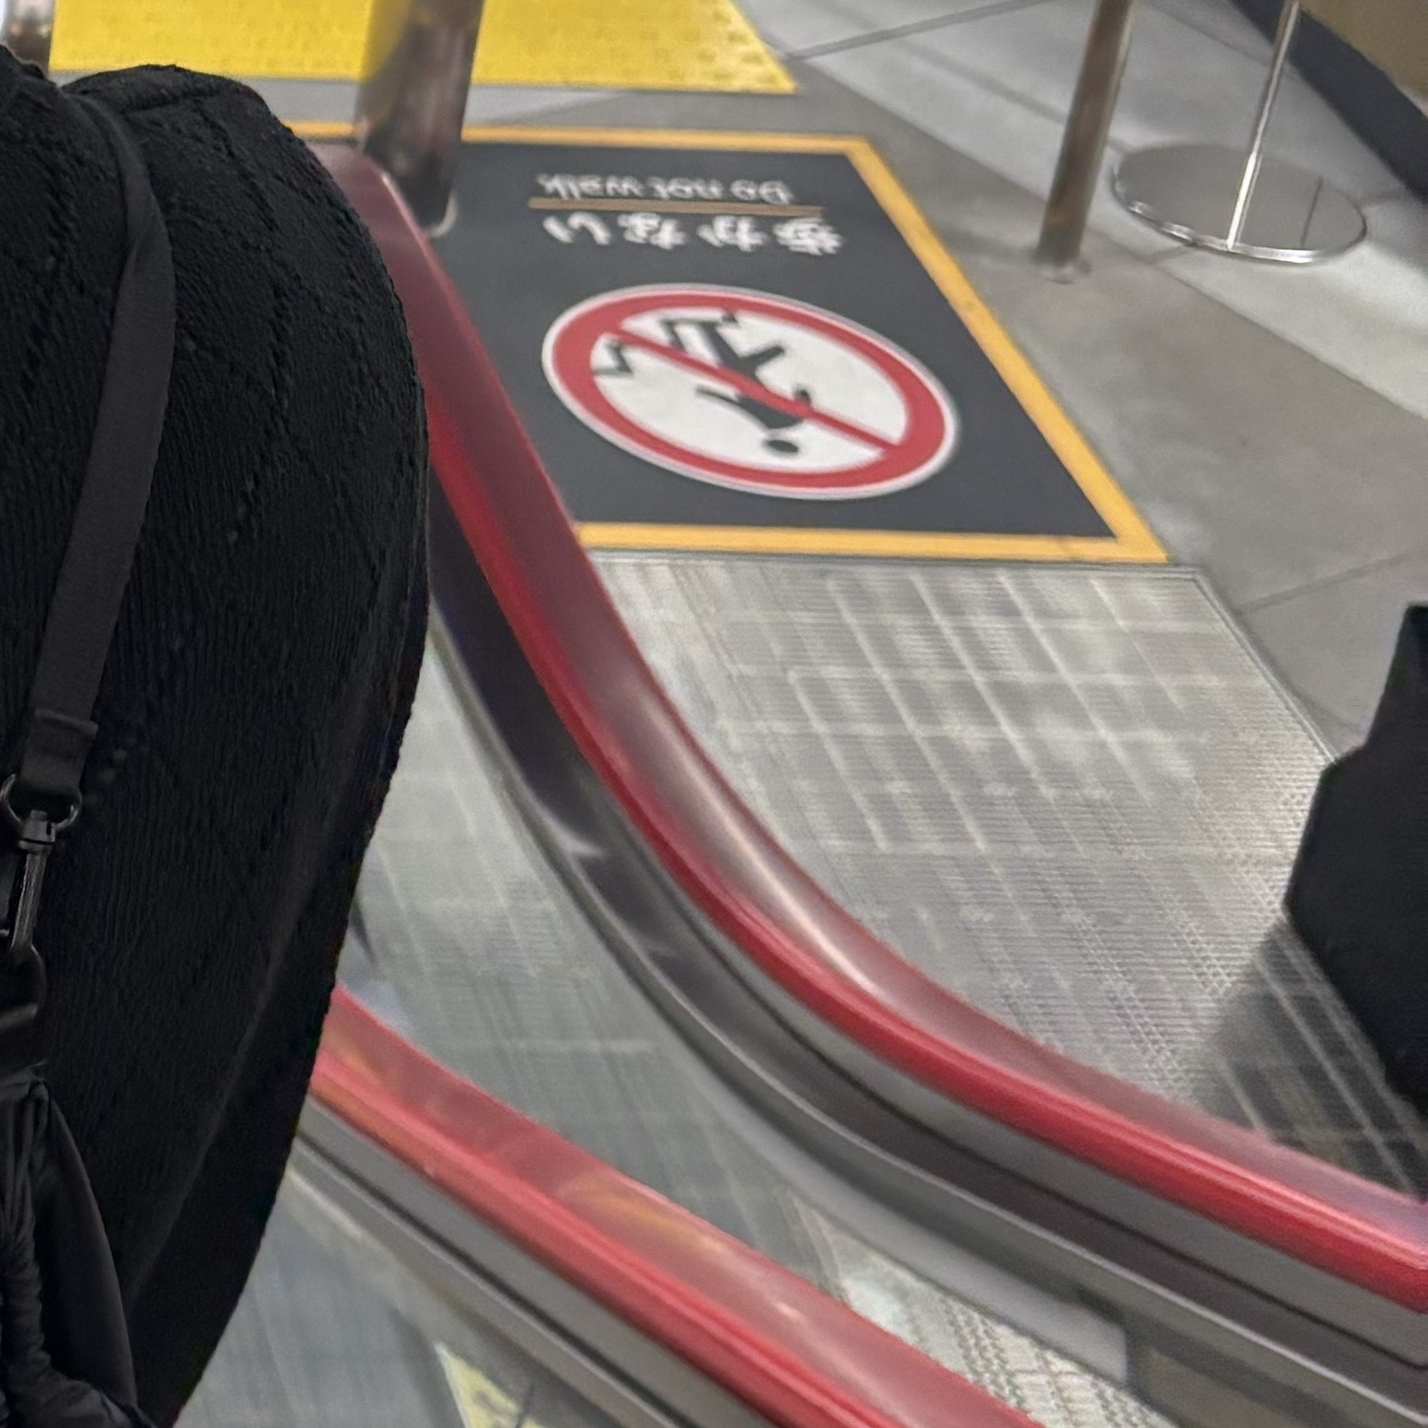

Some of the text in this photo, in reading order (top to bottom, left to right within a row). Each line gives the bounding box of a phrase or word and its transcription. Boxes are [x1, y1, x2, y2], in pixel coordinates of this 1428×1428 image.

[536, 173, 793, 205] Do not walk
[543, 211, 843, 256] 歩かない
